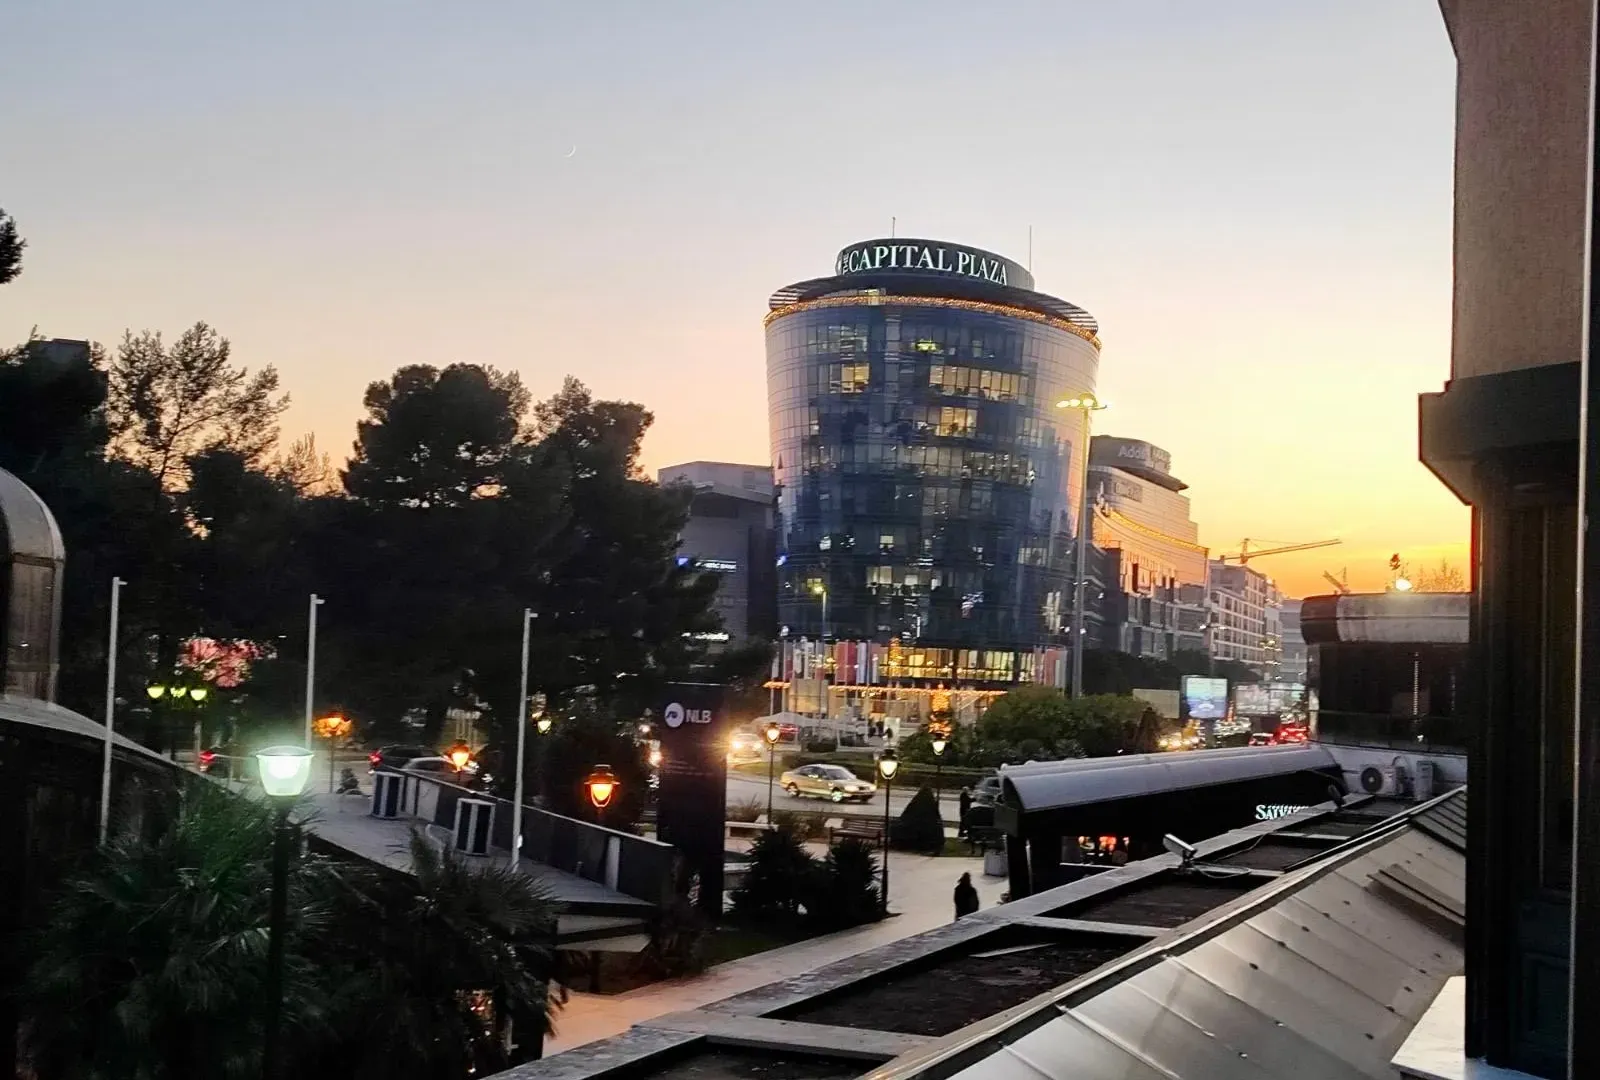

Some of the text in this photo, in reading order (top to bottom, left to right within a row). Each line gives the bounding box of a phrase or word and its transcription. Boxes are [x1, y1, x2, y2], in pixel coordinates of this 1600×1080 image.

[849, 245, 953, 273] CAPITAL
[956, 251, 1008, 286] PLAZA
[685, 708, 712, 724] NLB
